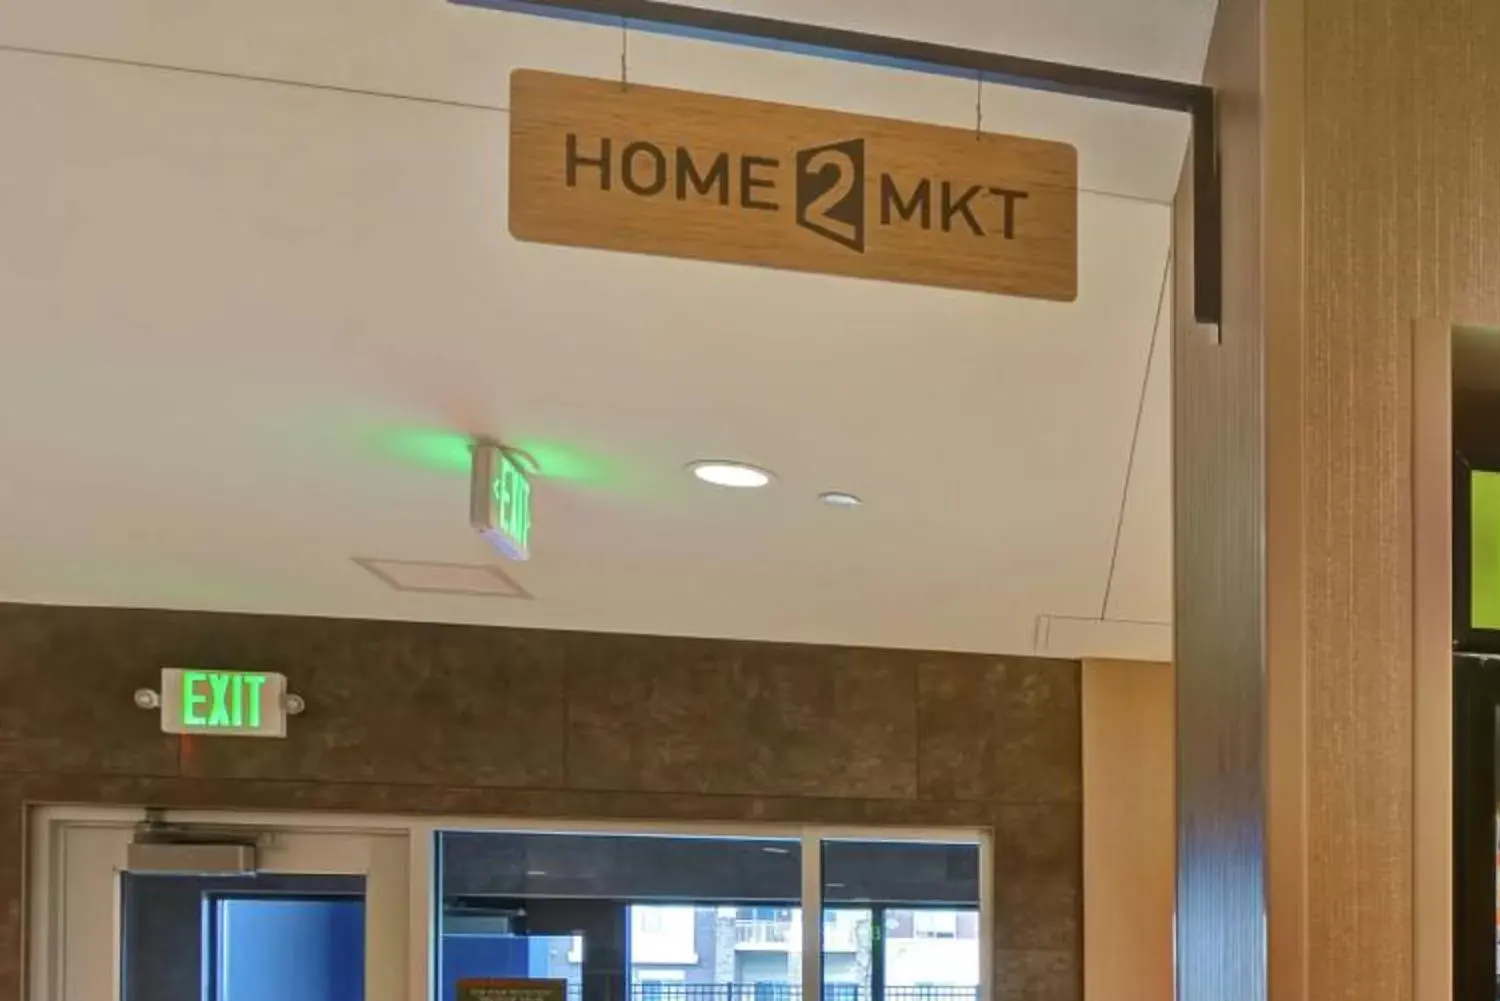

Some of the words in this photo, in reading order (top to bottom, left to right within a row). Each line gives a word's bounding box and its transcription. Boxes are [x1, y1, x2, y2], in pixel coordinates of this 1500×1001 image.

[565, 133, 780, 212] HOME
[802, 148, 861, 242] 2
[879, 173, 1028, 241] MKT
[183, 671, 266, 728] EXIT
